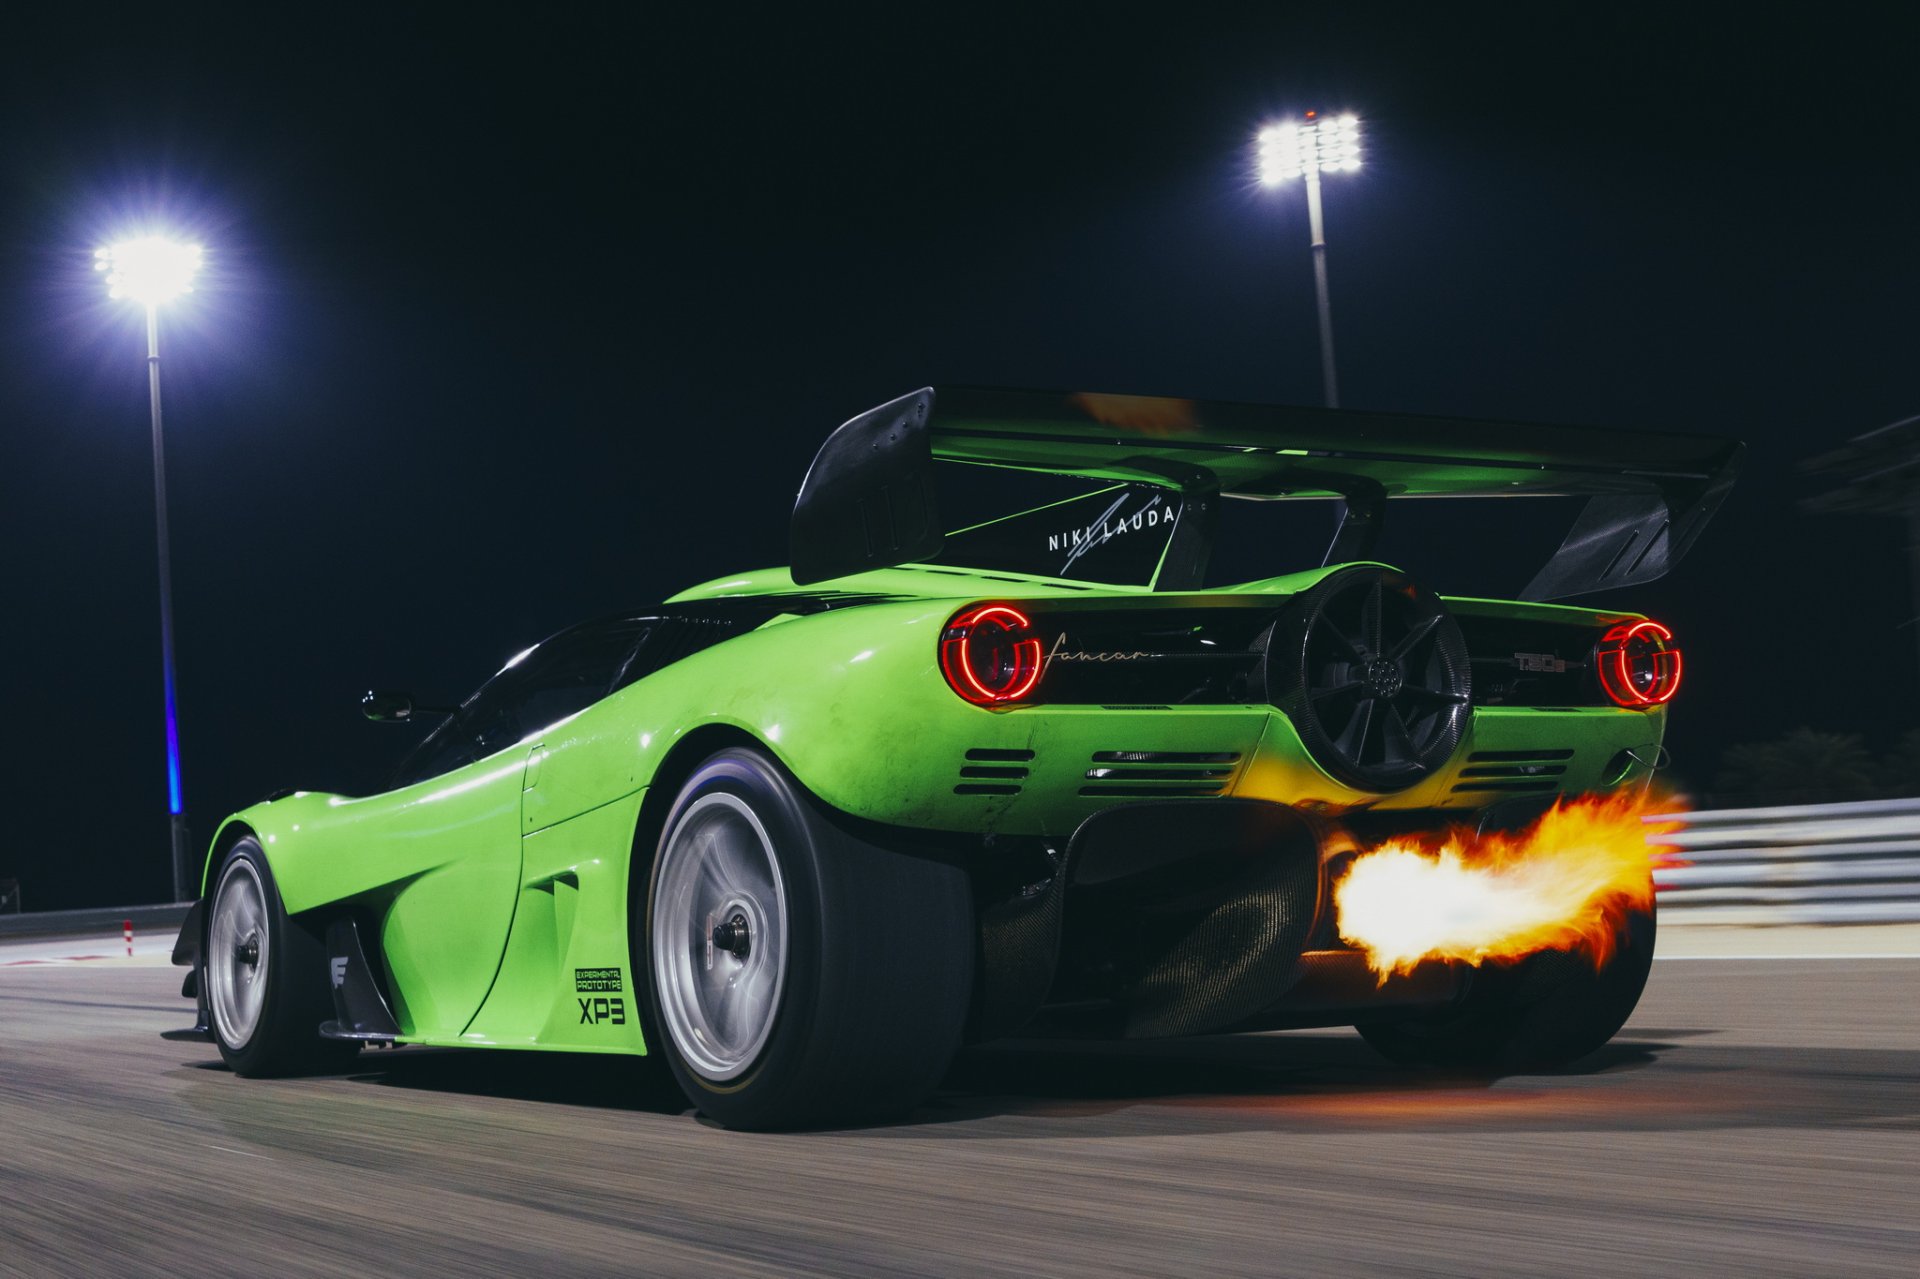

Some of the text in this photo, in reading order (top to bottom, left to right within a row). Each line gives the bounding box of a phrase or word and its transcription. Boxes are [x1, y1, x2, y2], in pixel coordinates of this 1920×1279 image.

[1049, 506, 1174, 551] NIKI LAUDA
[1038, 632, 1149, 680] fancar
[577, 980, 622, 990] PROTOTYPE
[578, 998, 626, 1025] XP3
